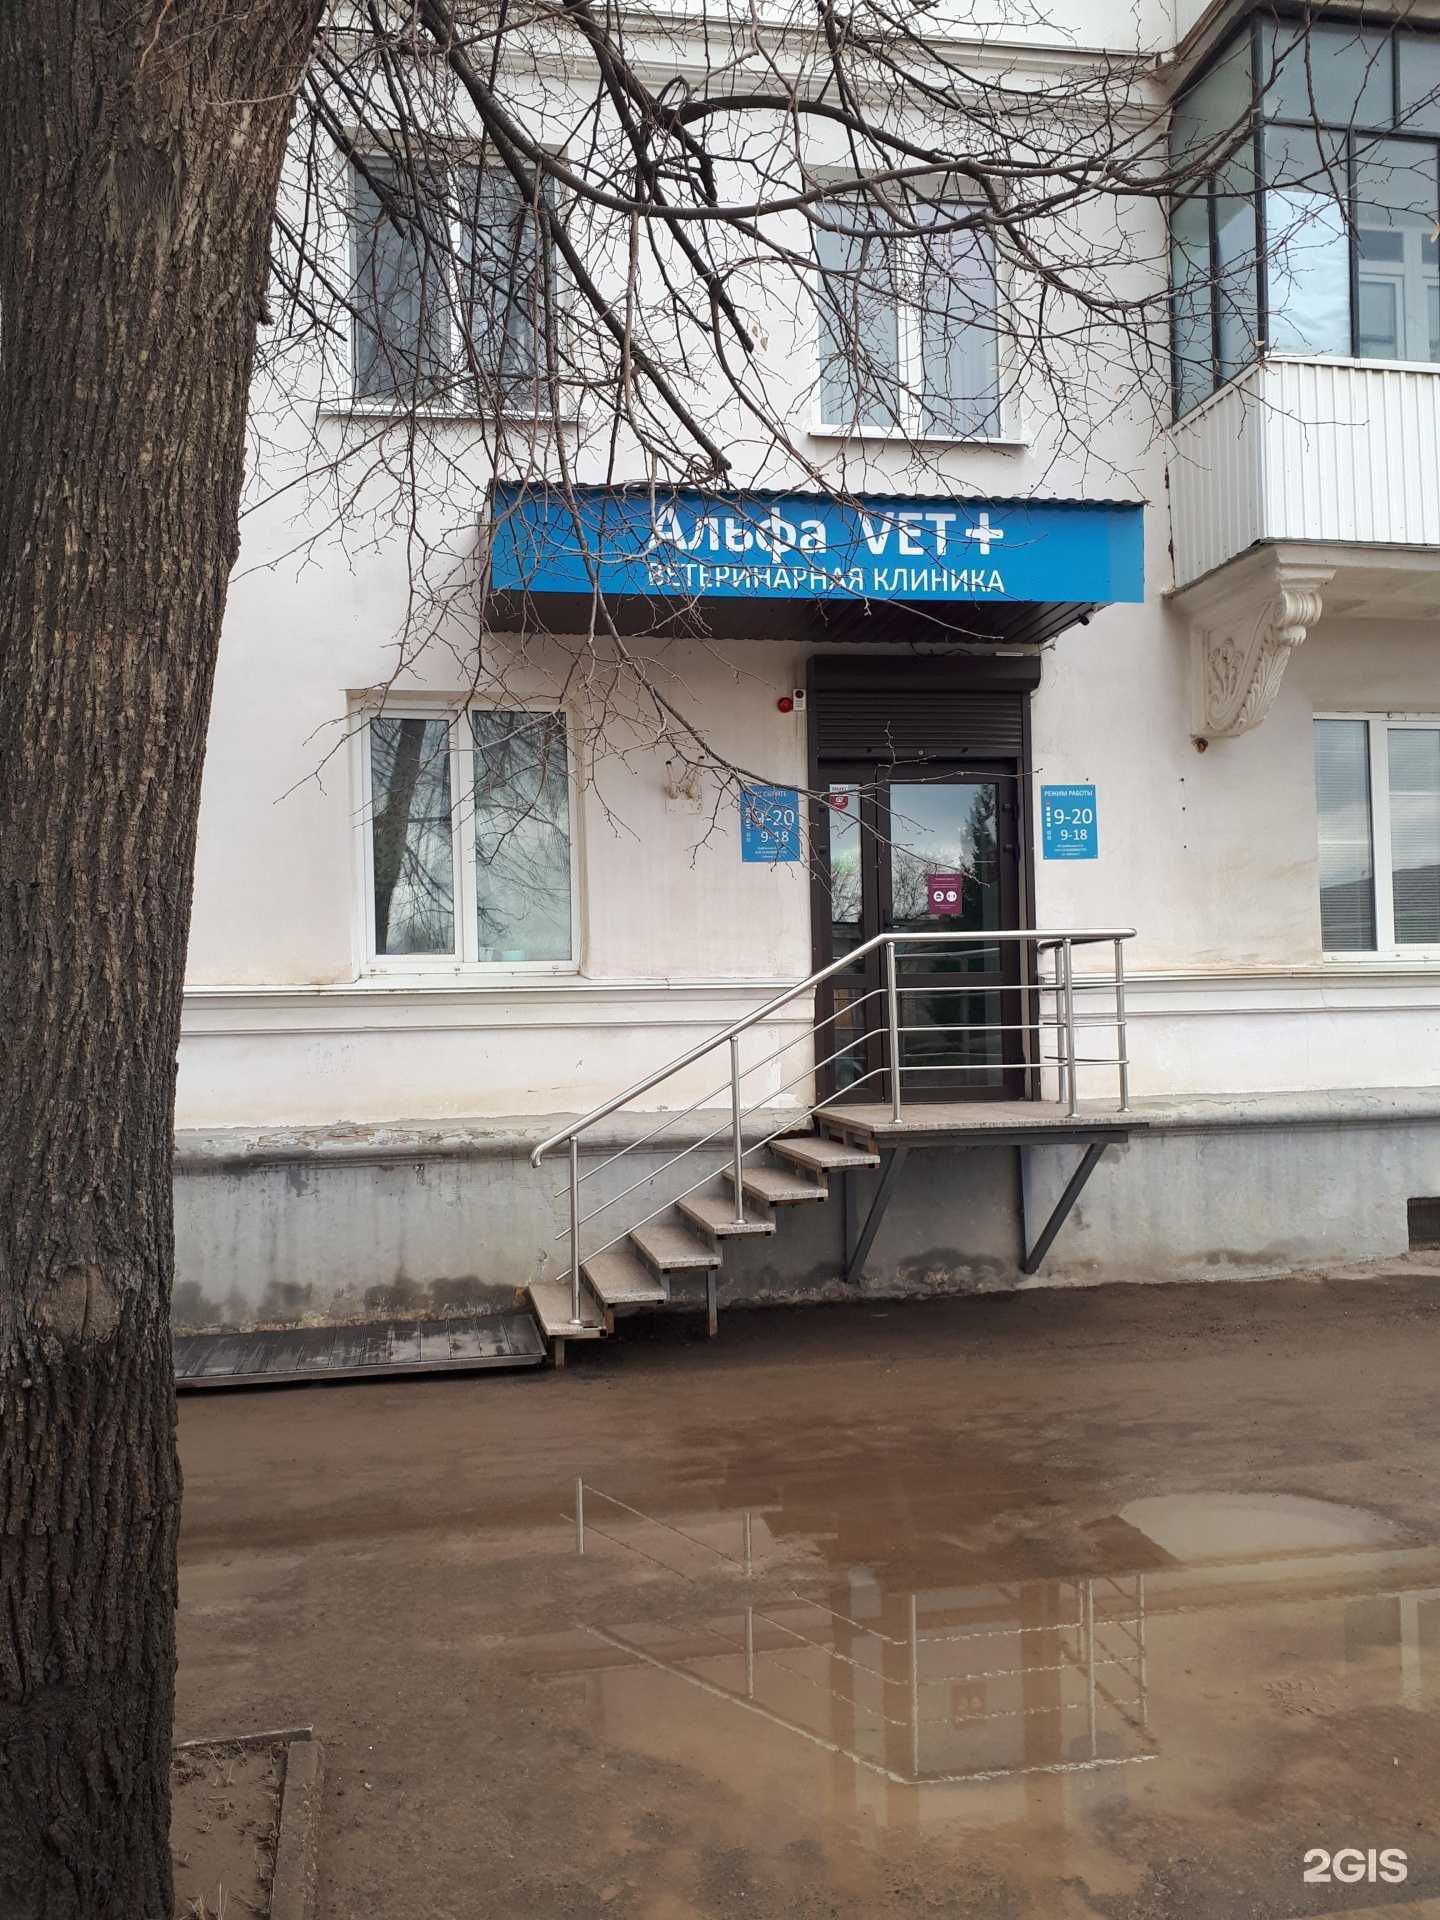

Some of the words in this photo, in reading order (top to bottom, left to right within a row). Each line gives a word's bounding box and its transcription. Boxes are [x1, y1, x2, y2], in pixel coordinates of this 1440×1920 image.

[647, 505, 827, 564] Альфа
[648, 562, 864, 591] ВЕТЕРИНАРНАЯ
[873, 568, 1005, 593] КЛИНИКА
[1054, 808, 1093, 825] 9-20
[1060, 829, 1088, 841] 9-18
